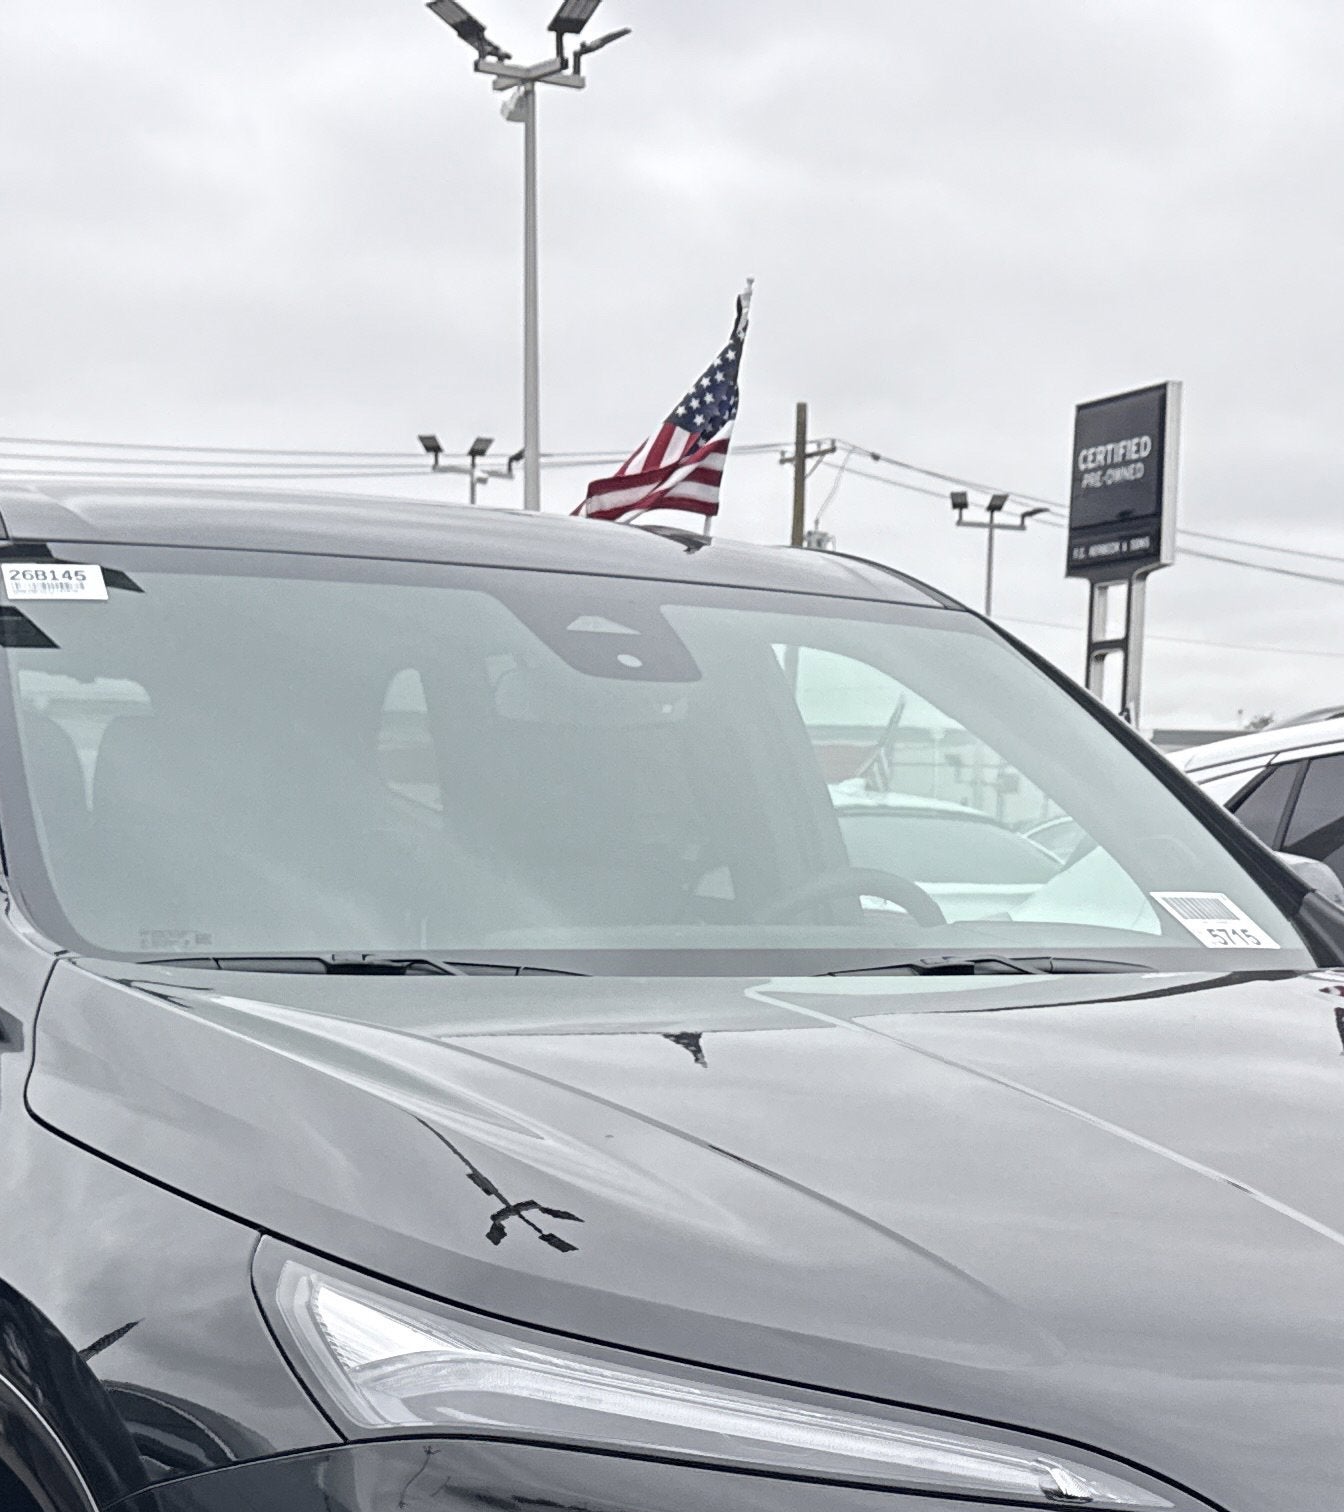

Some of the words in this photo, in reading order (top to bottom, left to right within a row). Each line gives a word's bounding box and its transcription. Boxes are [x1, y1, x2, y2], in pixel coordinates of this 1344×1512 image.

[1078, 435, 1152, 471] CERTIFIED
[1081, 462, 1145, 489] PRE-OWNED
[8, 569, 87, 582] 26B145
[1206, 928, 1261, 946] 5715
